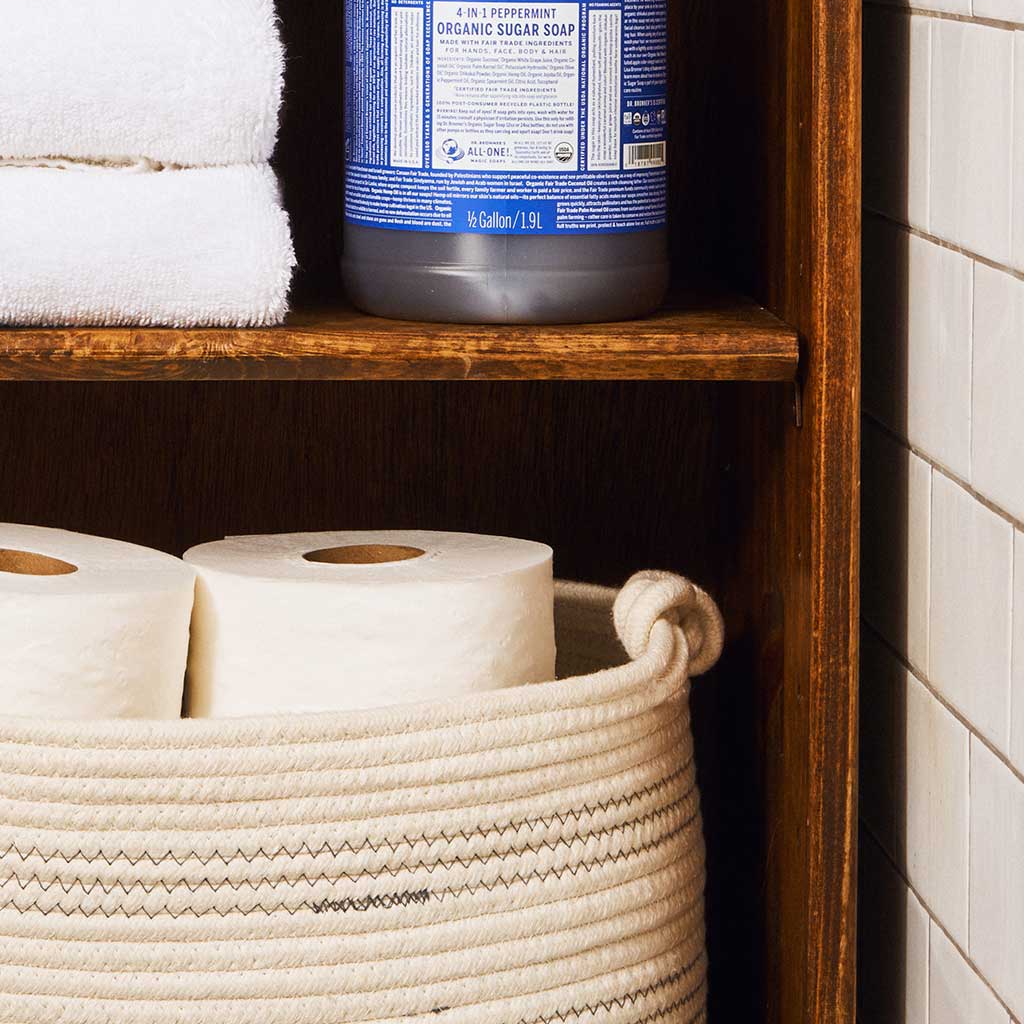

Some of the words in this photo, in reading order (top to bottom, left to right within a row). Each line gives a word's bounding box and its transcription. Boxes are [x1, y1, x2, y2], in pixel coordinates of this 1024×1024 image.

[456, 8, 486, 18] 4-IN-1
[491, 8, 556, 19] PEPPERMINT
[437, 22, 493, 36] ORGANIC
[497, 23, 539, 36] SUGAR
[543, 24, 575, 37] SOAP
[467, 147, 509, 157] ALL-ONE!
[479, 210, 542, 229] Gallon/1.9L
